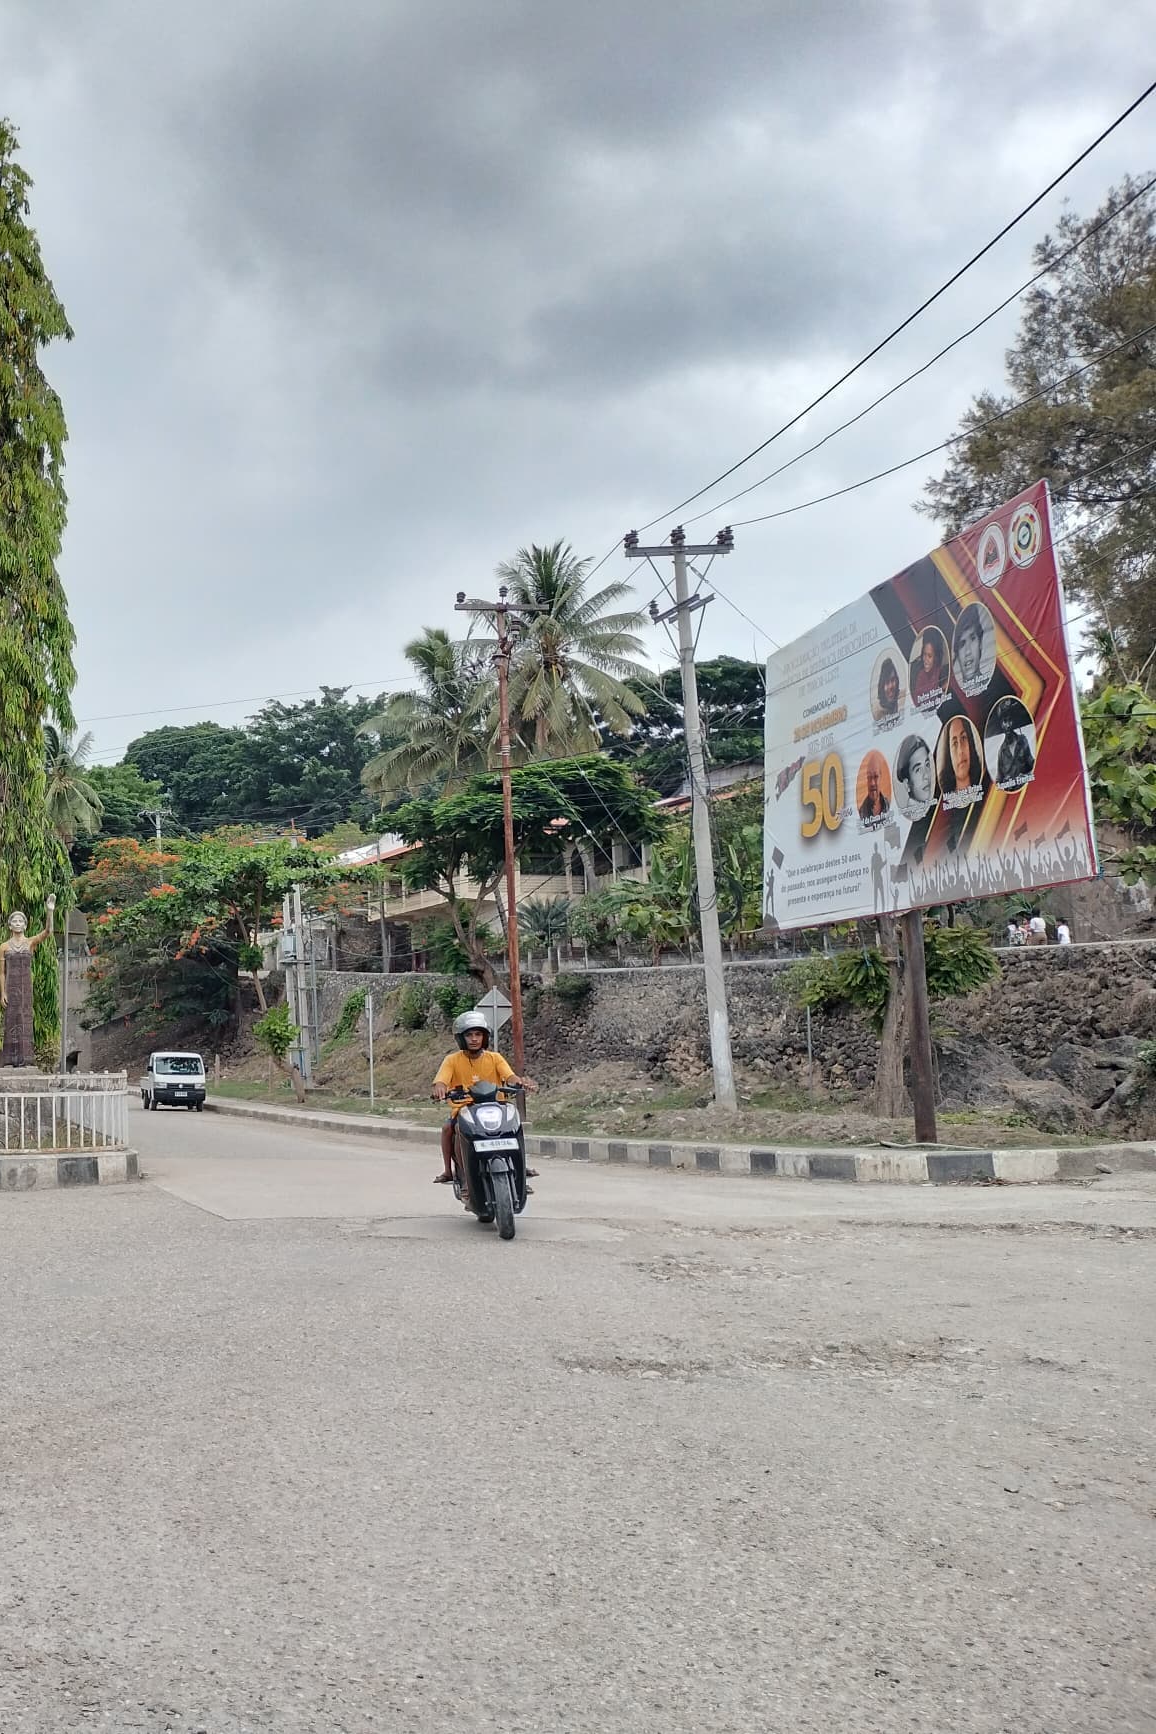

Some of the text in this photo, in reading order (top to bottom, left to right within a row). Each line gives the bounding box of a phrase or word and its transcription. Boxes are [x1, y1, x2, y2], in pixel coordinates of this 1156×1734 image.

[801, 752, 844, 838] 50
[841, 854, 848, 864] 50
[838, 868, 861, 881] confiança
